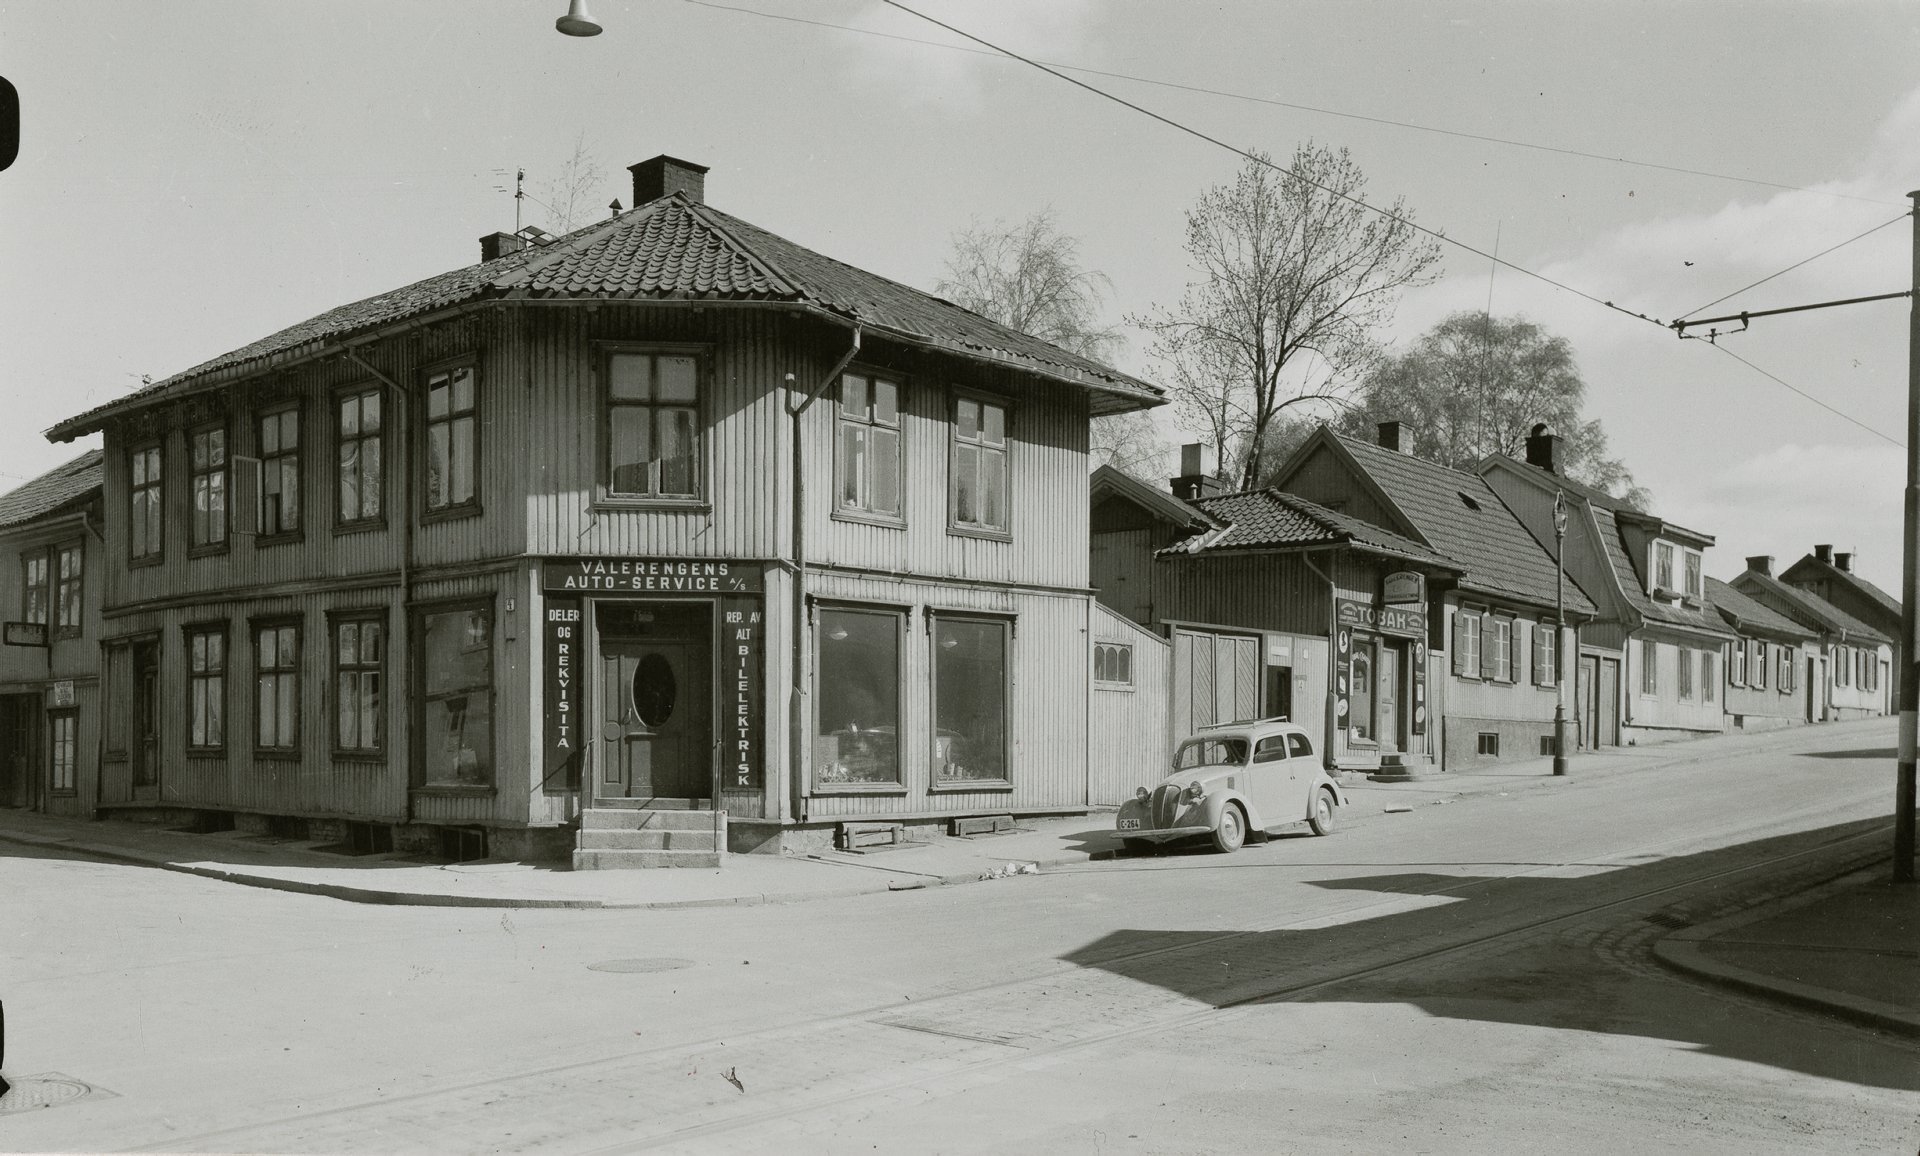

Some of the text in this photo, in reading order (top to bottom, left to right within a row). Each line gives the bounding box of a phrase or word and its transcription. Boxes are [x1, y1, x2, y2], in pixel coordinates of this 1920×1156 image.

[564, 576, 746, 591] AUTO-SERVICE A/S
[548, 609, 580, 622] DELER
[726, 612, 762, 623] REP. AV
[1357, 605, 1407, 630] TOBAK
[557, 626, 571, 638] OG
[736, 628, 751, 640] ALT
[557, 643, 570, 748] REKVISITA
[738, 645, 749, 786] BILELEKTRISK
